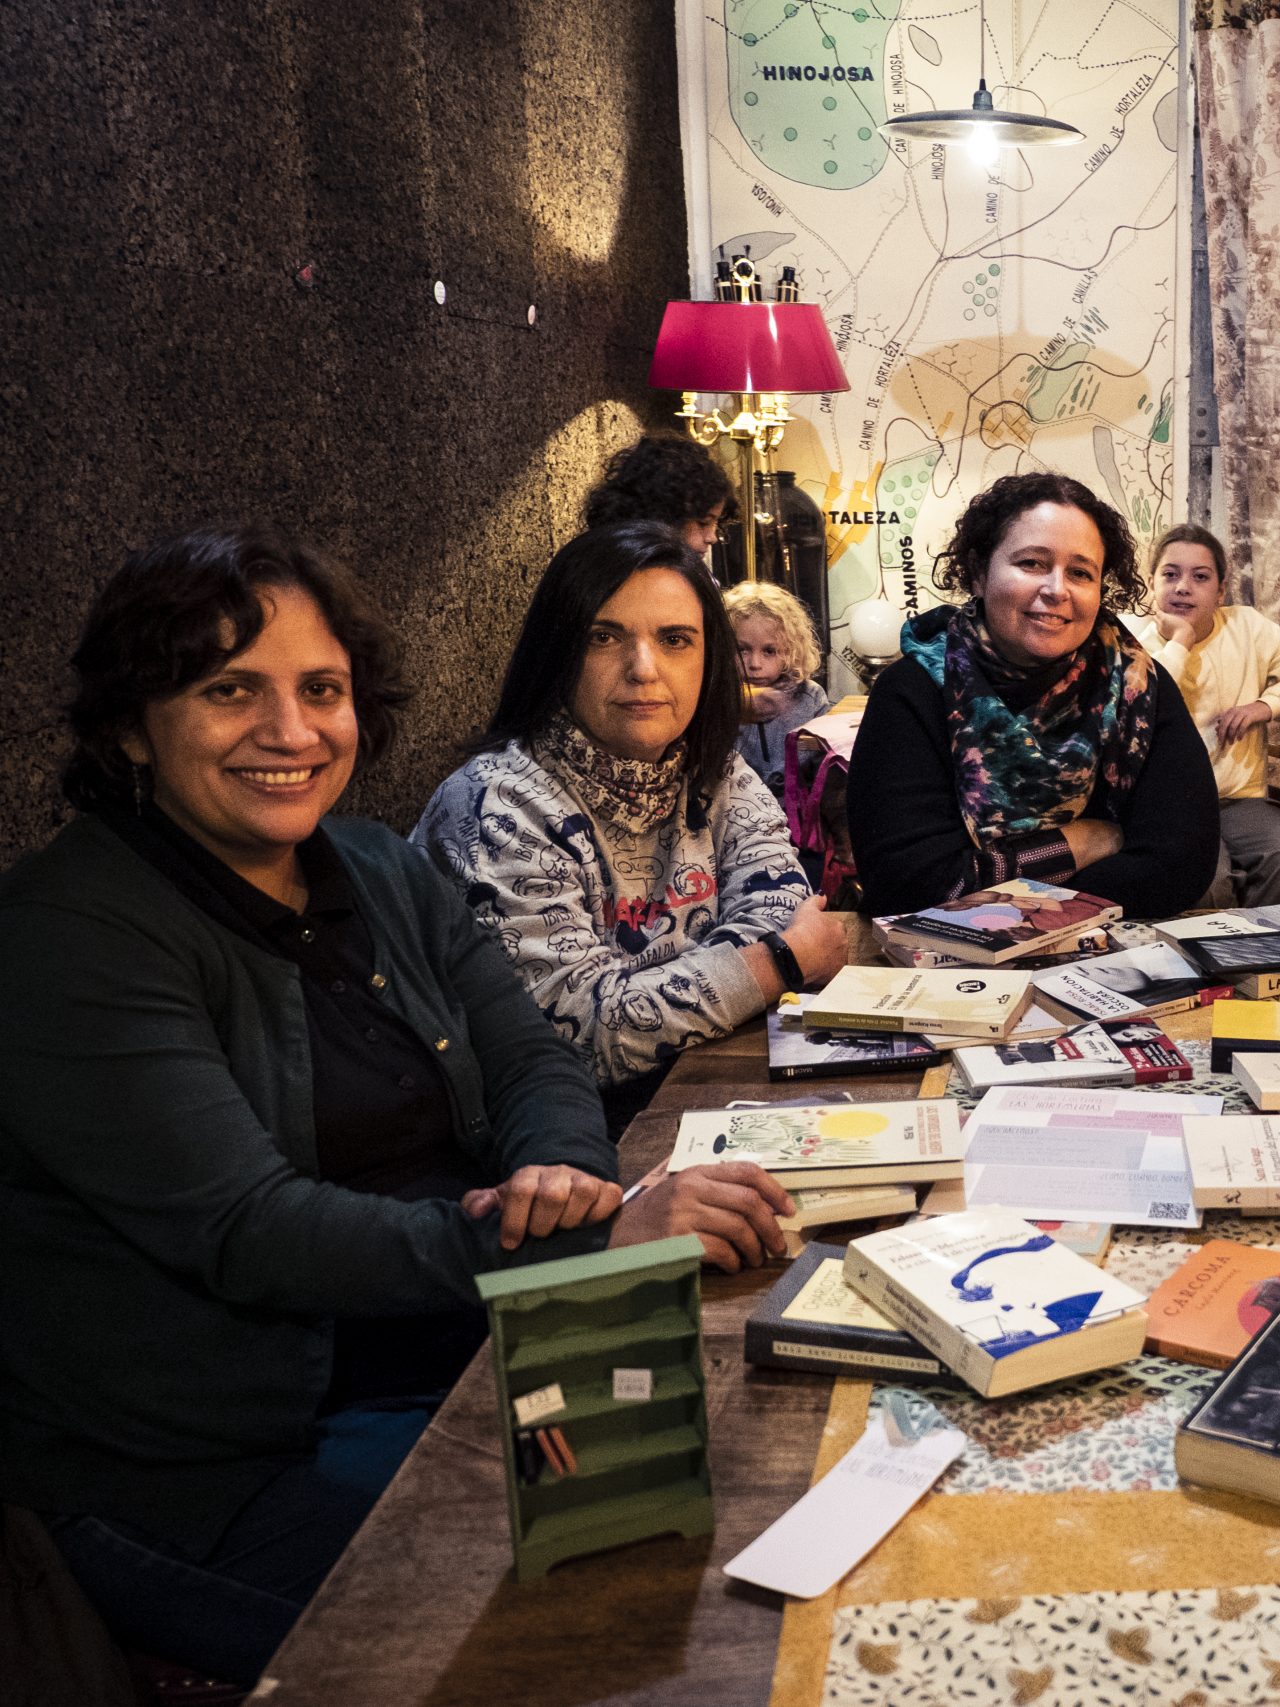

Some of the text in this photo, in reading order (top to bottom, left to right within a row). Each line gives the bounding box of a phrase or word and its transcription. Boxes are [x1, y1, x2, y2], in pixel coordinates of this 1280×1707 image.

[763, 65, 875, 82] HINOJOSA
[890, 53, 902, 95] HINOJOSA
[893, 102, 905, 113] DE
[1083, 73, 1154, 174] CAMINO DE HORTALEZA
[751, 183, 785, 218] HINOJOSA
[986, 192, 998, 223] CAMINO
[1039, 268, 1099, 362] CAMINO DE CANILLAS
[858, 340, 902, 451] CAMINO DE HORTALEZA
[824, 511, 901, 525] TALEZA
[900, 535, 919, 620] CAMINOS
[1094, 989, 1131, 1011] OSCURA
[1163, 1255, 1231, 1317] CARCOMA
